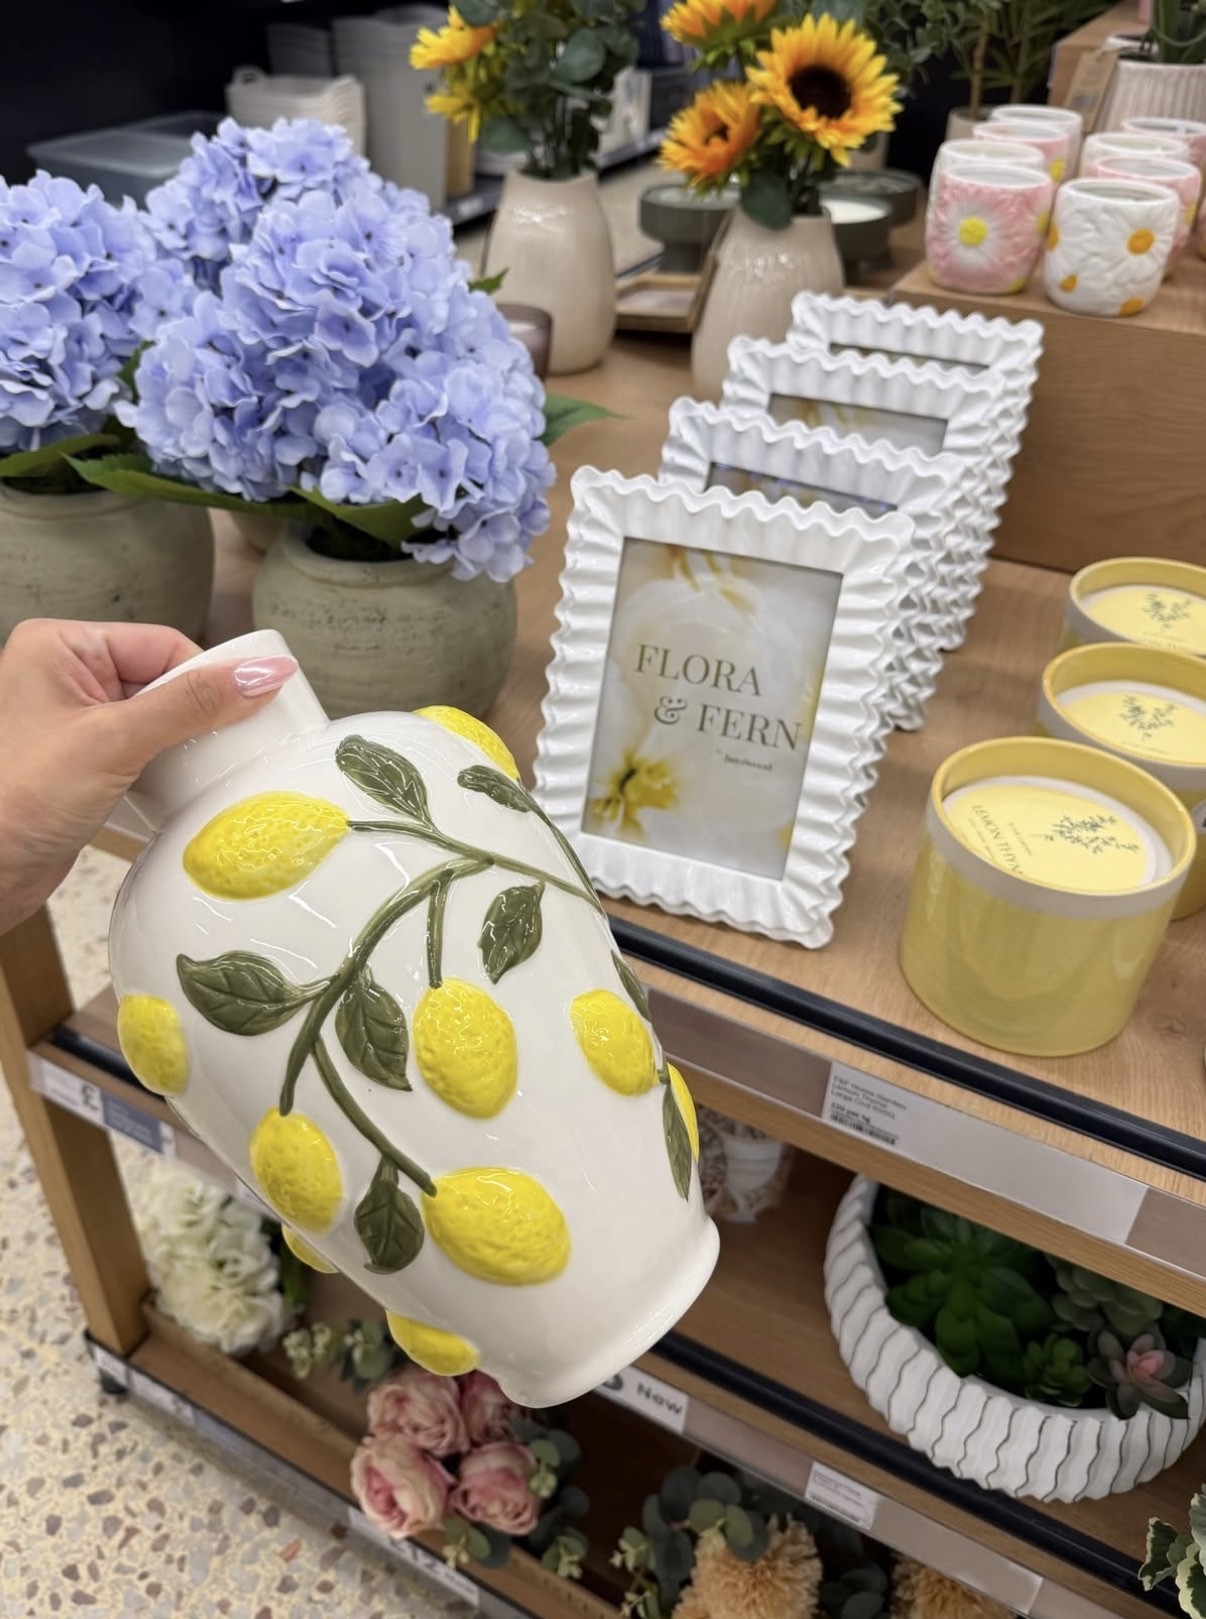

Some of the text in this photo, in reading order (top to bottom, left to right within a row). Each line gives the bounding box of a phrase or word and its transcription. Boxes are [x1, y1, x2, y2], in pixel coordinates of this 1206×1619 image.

[634, 643, 762, 697] FLORA
[653, 695, 802, 751] & FERN
[971, 804, 1006, 839] LEMON
[997, 841, 1024, 875] THYM
